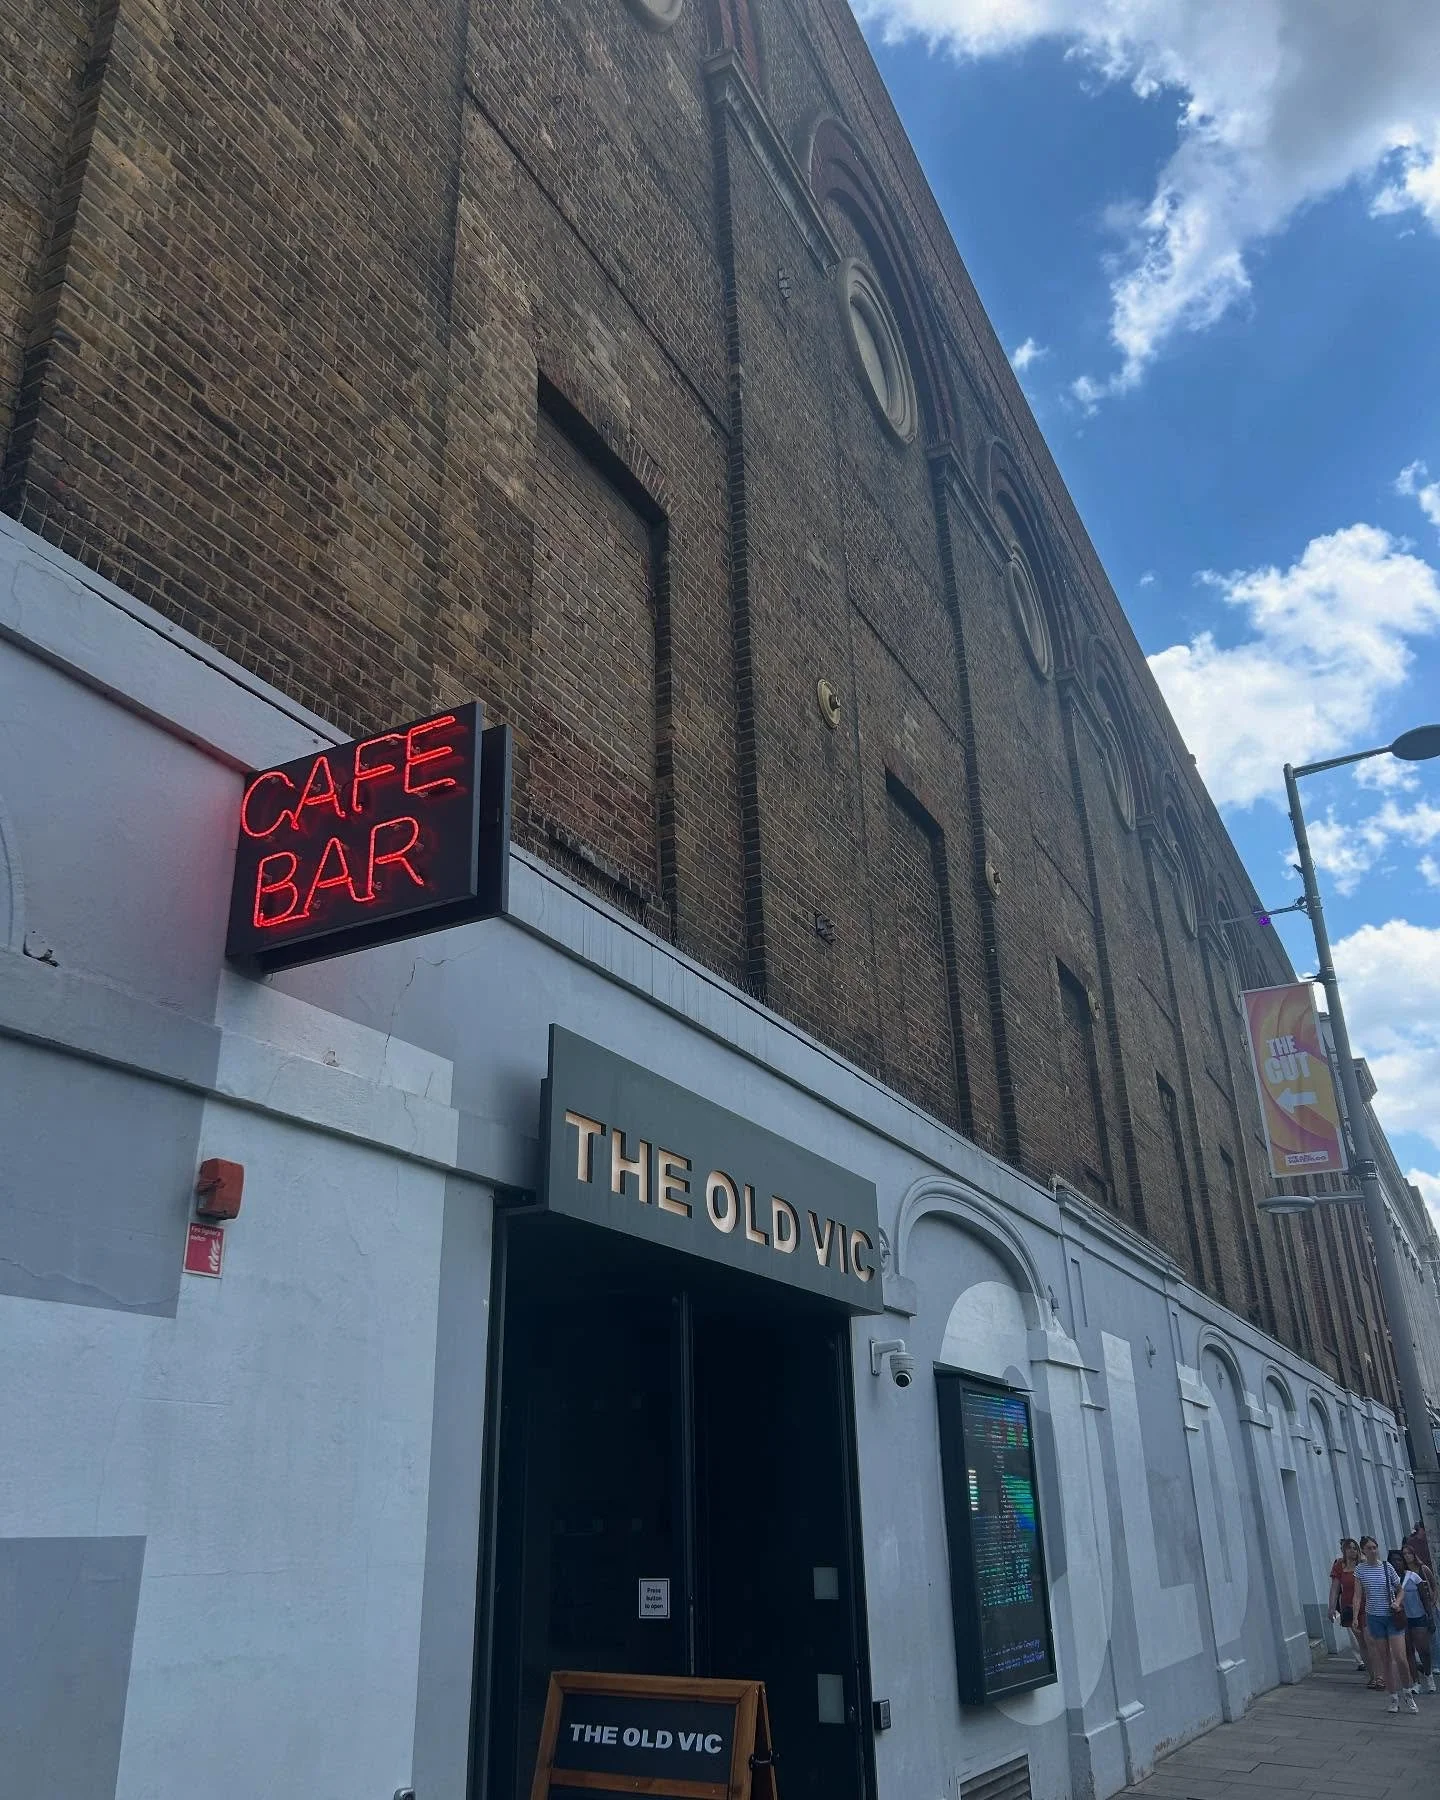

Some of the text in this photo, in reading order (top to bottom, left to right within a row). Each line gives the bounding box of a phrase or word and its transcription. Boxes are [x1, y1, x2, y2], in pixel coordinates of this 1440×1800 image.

[241, 715, 456, 837] CAFE
[254, 816, 425, 928] BAR
[1266, 1035, 1297, 1057] THE
[565, 1108, 874, 1283] THE OLD VIC
[570, 1723, 723, 1754] THE OLD VIC
